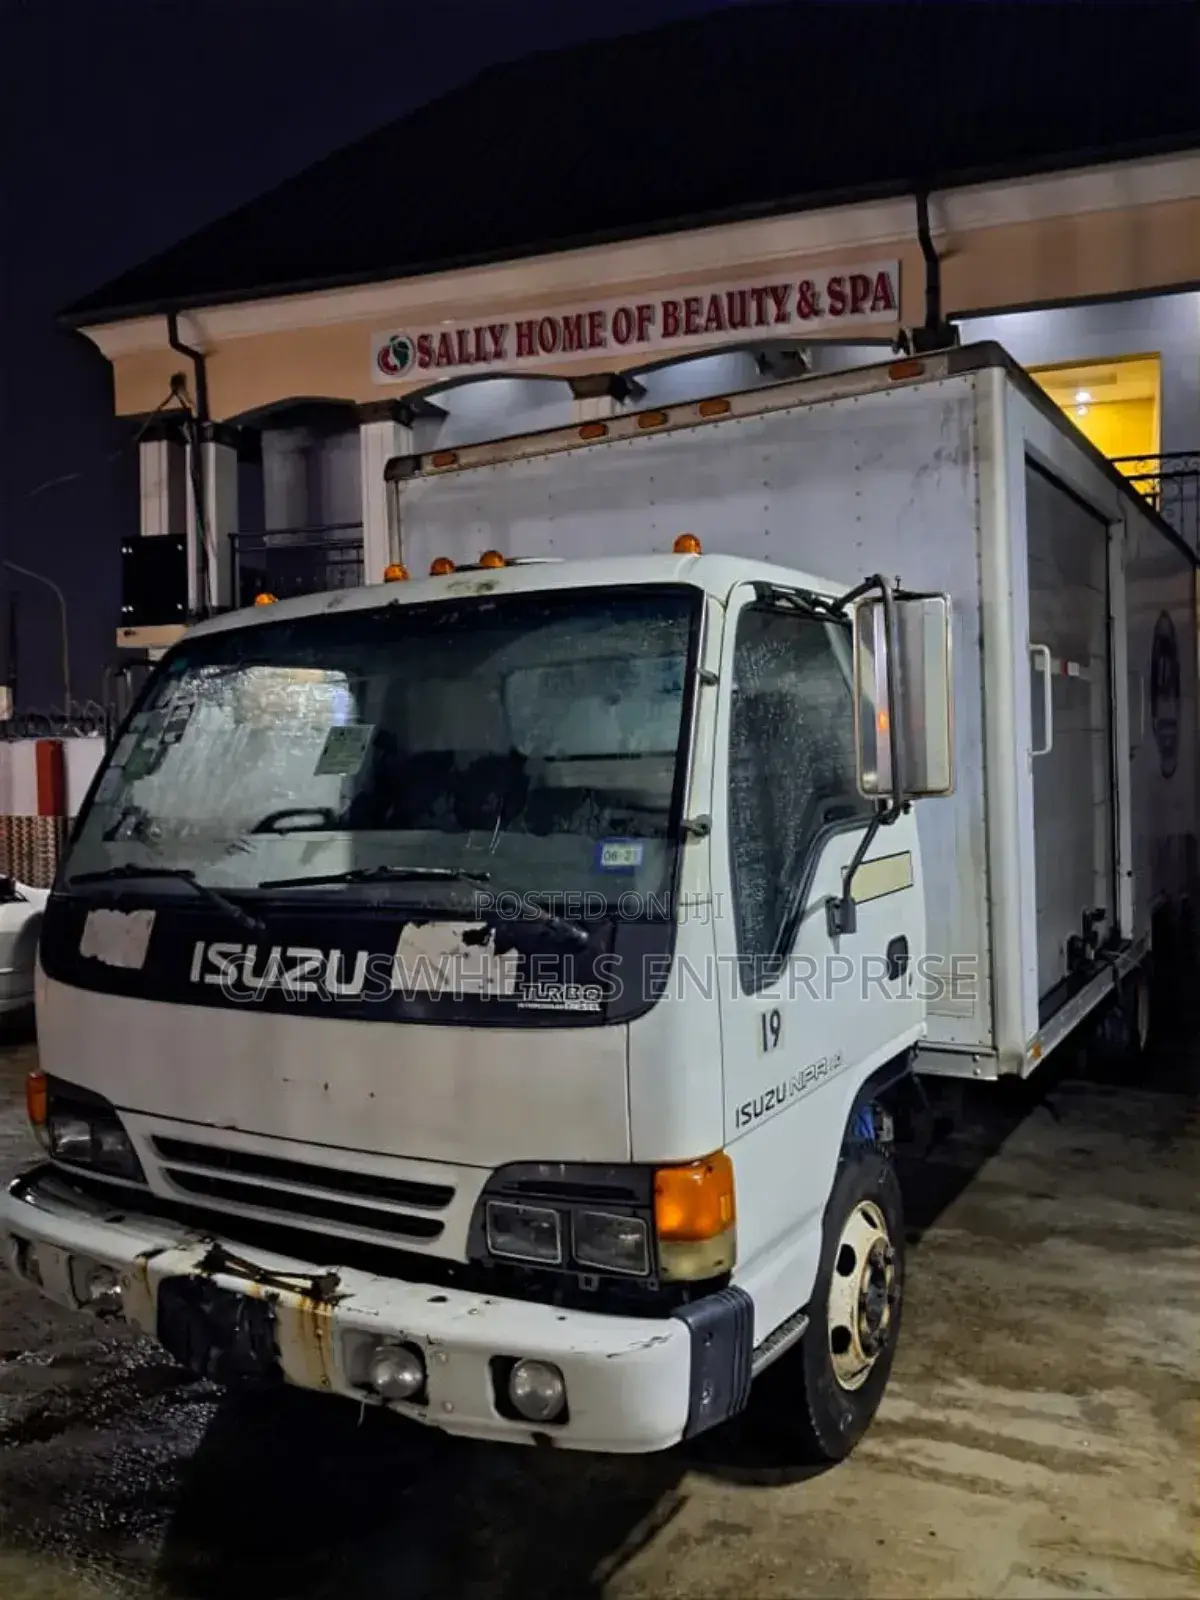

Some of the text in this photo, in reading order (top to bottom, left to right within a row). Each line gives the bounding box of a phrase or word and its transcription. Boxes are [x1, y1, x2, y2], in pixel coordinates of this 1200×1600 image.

[417, 271, 897, 369] SALLY HOME OF BEAUTY & SPA
[190, 941, 369, 994] ISUZU
[520, 983, 603, 1002] TURBO
[761, 1008, 781, 1052] 19
[735, 1080, 787, 1129] ISUZU
